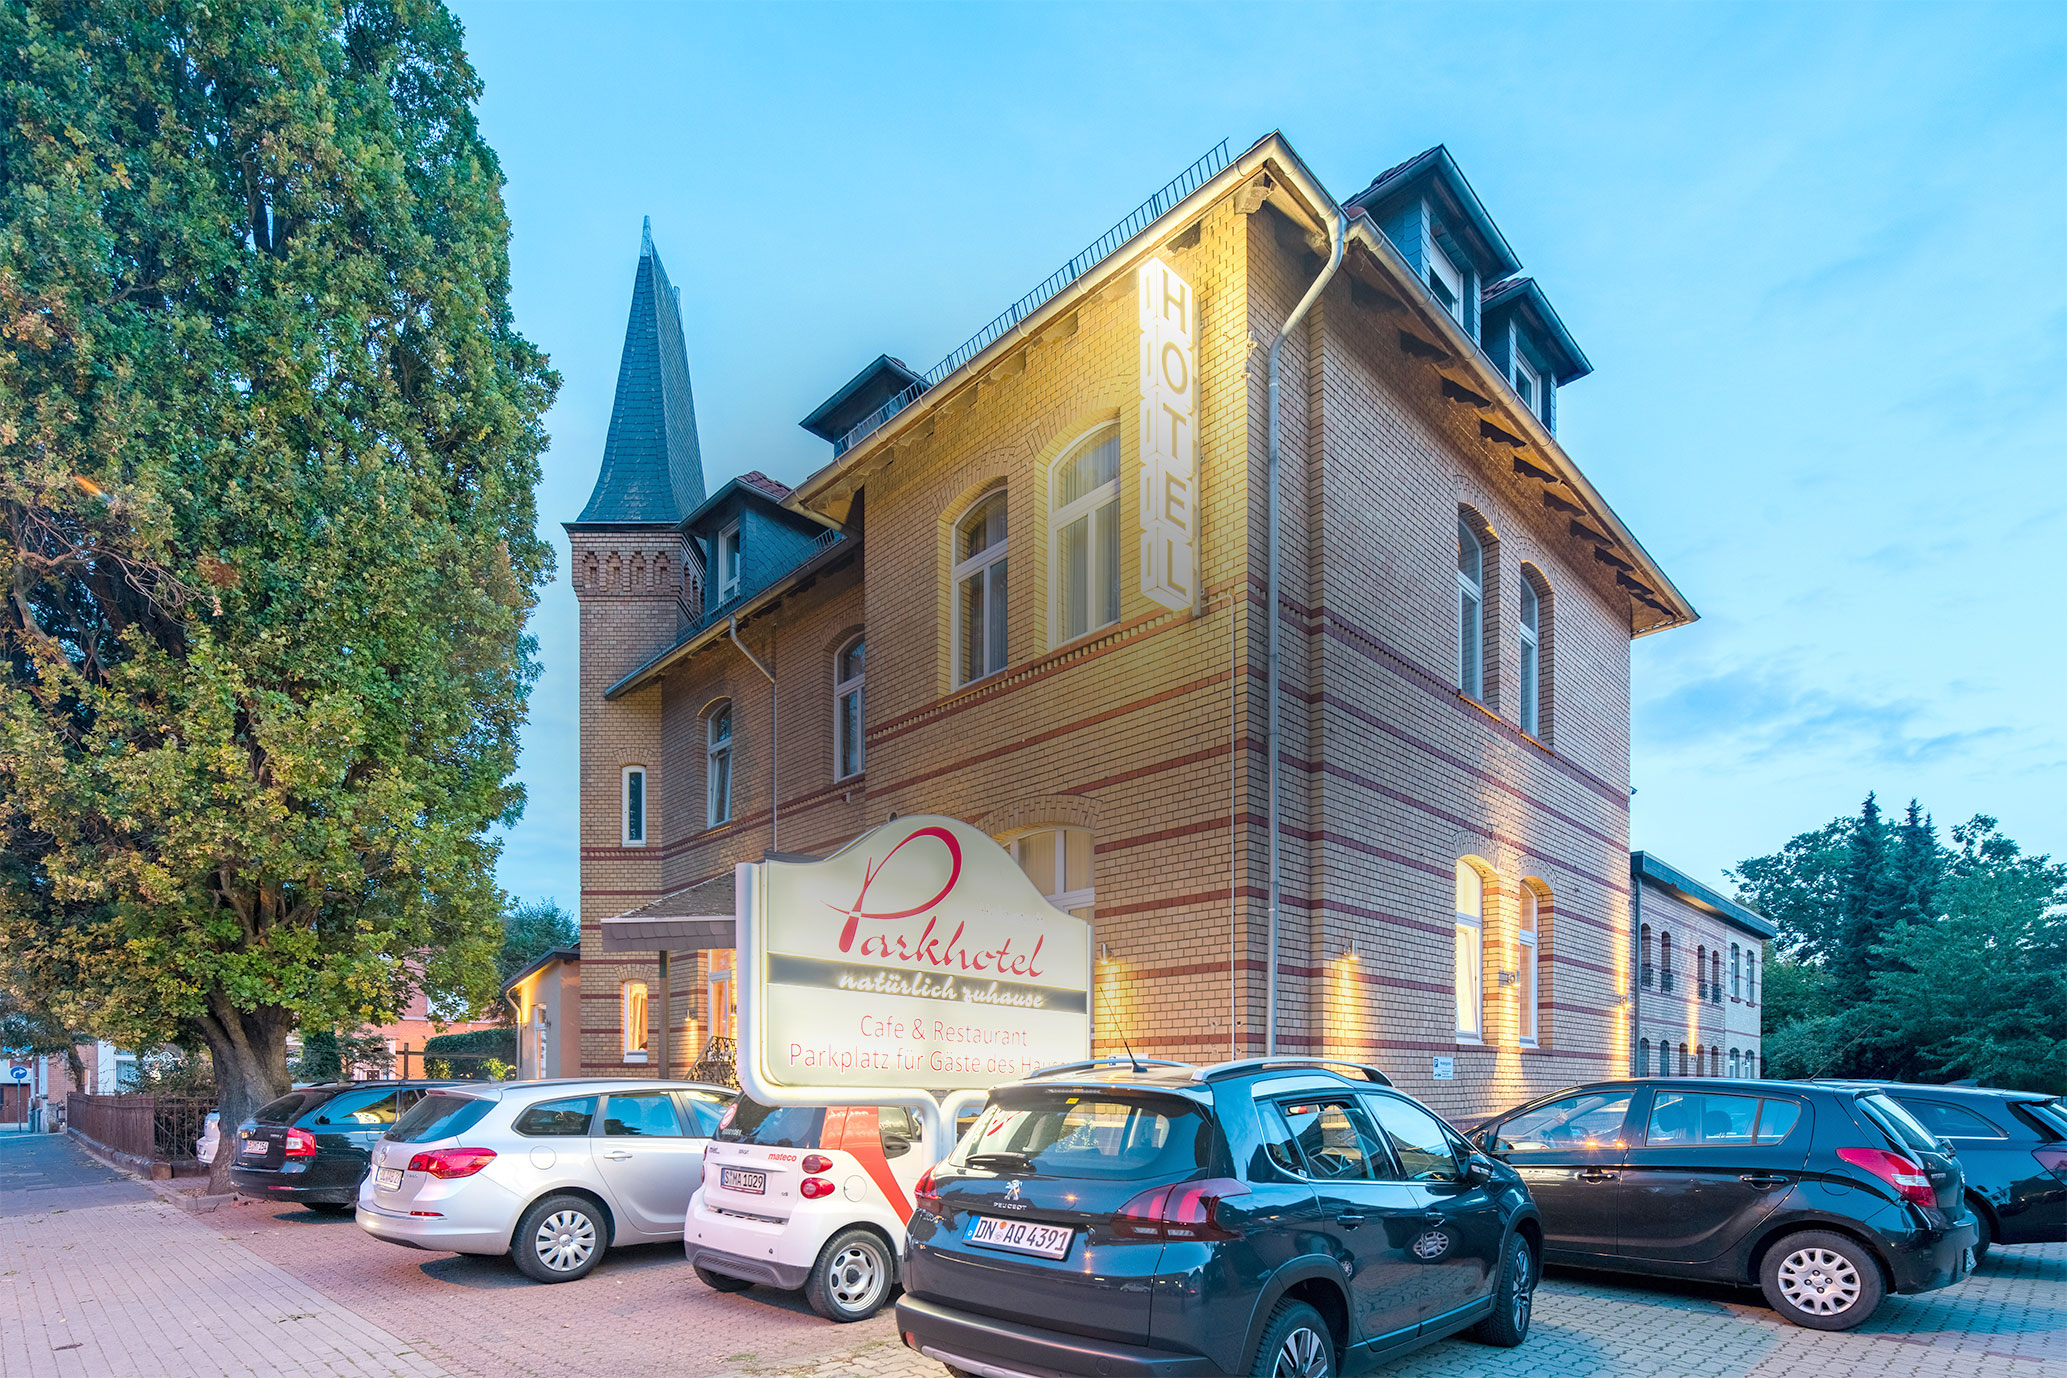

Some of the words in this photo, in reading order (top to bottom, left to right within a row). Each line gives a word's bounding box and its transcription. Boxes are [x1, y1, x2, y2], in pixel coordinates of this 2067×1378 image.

[1161, 268, 1187, 597] HOTEL
[819, 826, 1044, 977] Parkhotel
[839, 972, 957, 1001] natürlich
[962, 982, 1045, 1009] zuhause
[911, 1018, 926, 1041] &
[934, 1020, 1027, 1047] Restaurant
[790, 1043, 889, 1073] Parkplatz
[897, 1048, 924, 1071] für
[930, 1050, 981, 1073] Gäste
[987, 1053, 1015, 1074] des
[768, 1153, 797, 1162] mateco
[743, 1173, 763, 1189] 1029
[993, 1201, 1027, 1211] PEUGEOT
[975, 1219, 997, 1240] DN
[1003, 1223, 1027, 1244] AQ
[1026, 1226, 1068, 1252] 4391
